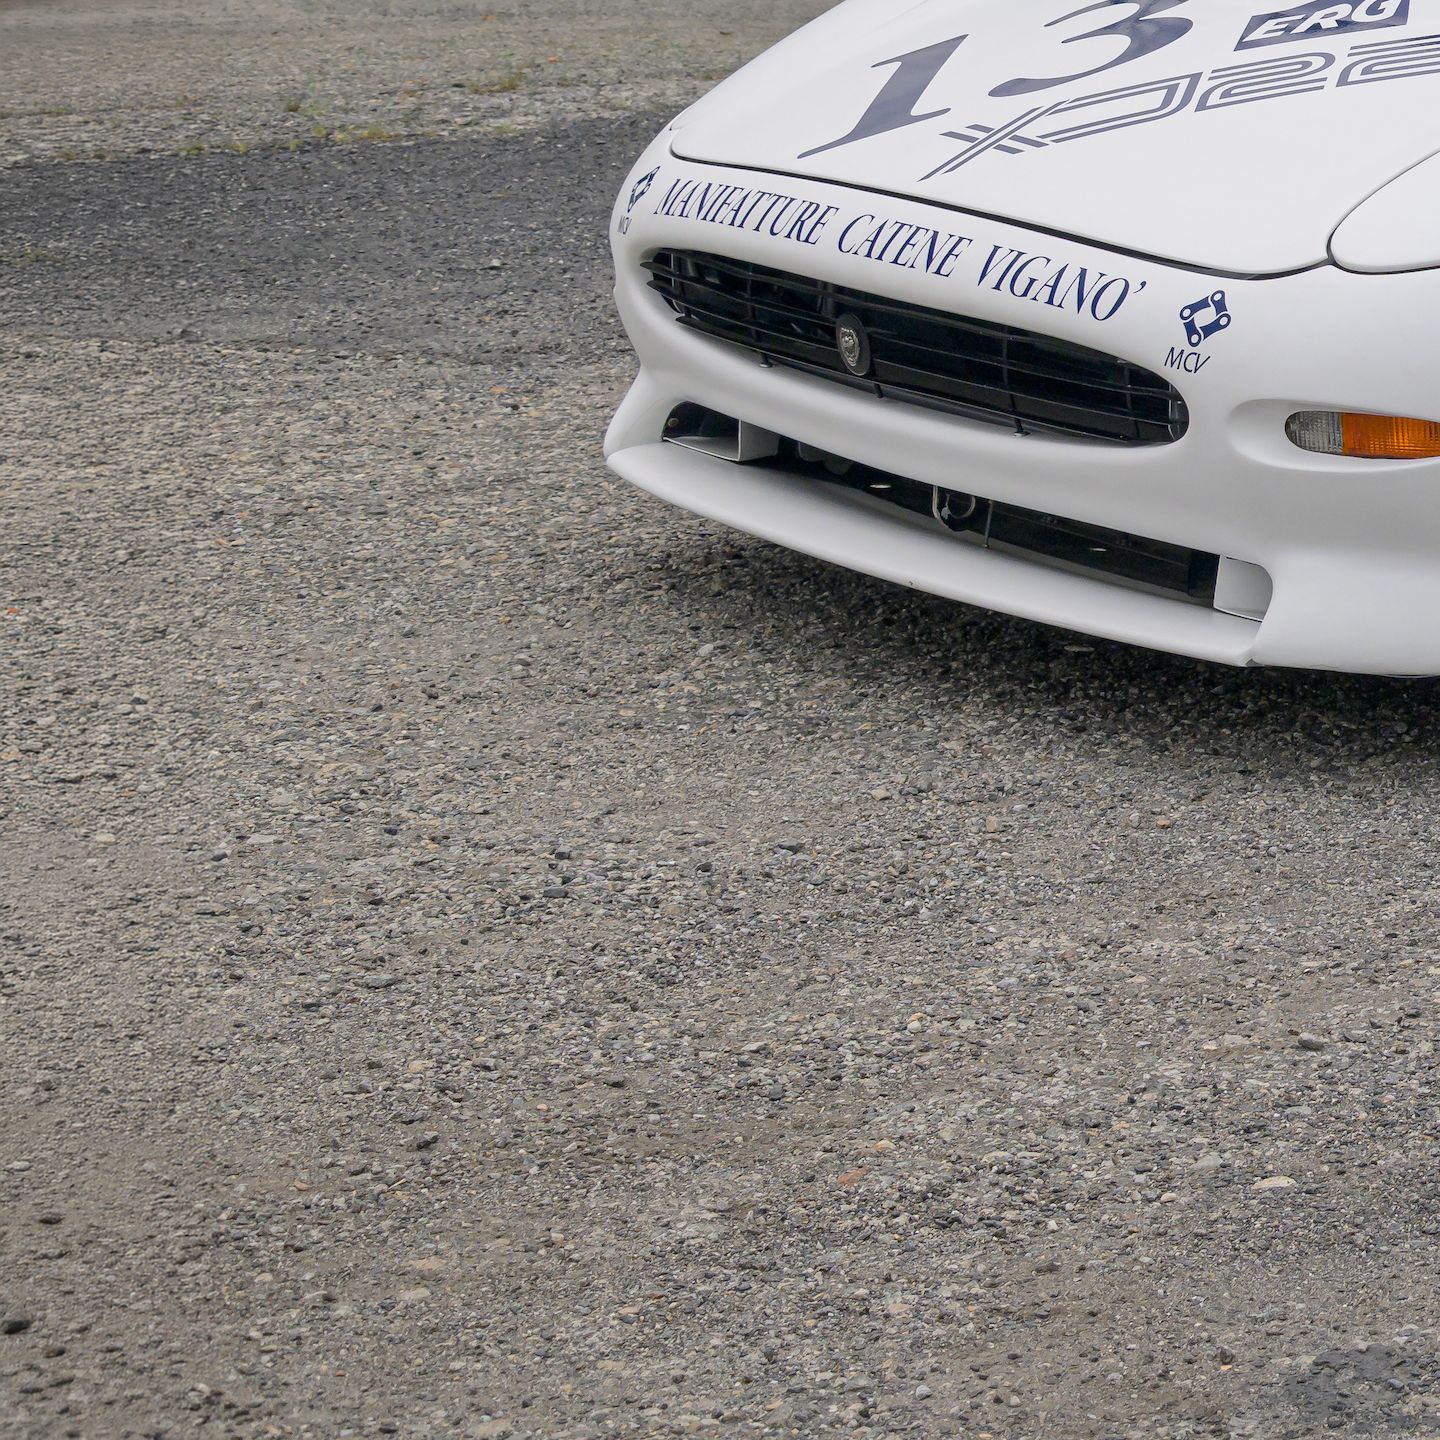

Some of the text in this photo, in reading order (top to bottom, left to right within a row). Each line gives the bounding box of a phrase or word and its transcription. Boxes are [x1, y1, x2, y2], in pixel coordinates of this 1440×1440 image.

[653, 178, 840, 246] MANIFATTURE
[838, 214, 973, 278] CATENE
[1164, 346, 1211, 374] MCV
